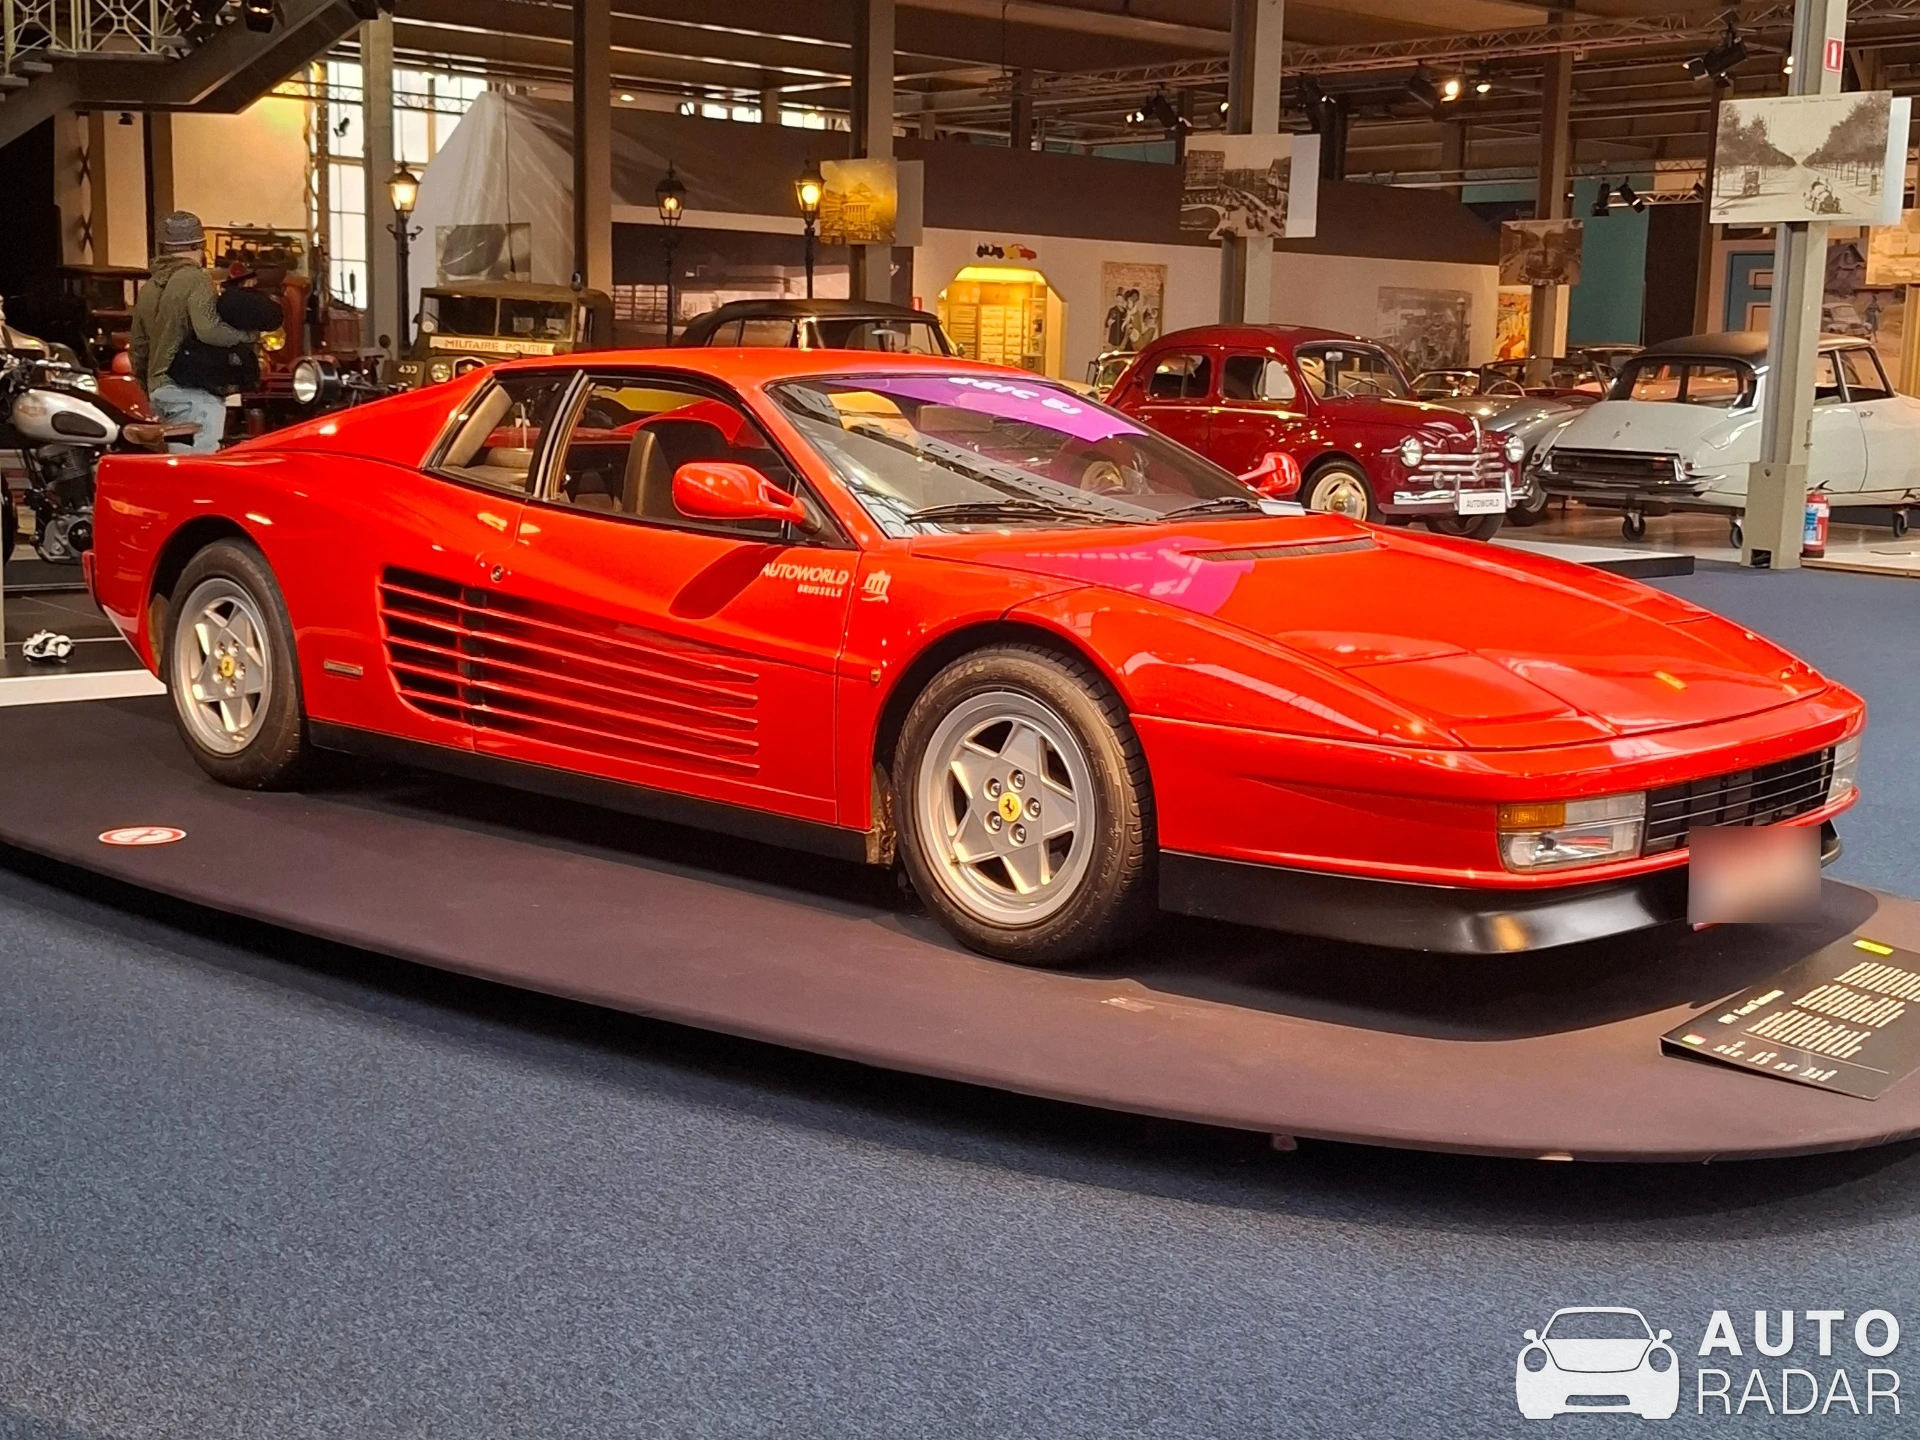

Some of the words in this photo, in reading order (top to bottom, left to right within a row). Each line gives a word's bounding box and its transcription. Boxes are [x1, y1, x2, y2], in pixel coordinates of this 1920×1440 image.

[444, 338, 499, 351] MILITAIRE
[398, 365, 418, 375] 433
[761, 562, 850, 586] AUTOWORLD
[797, 583, 843, 598] BRUSSELS
